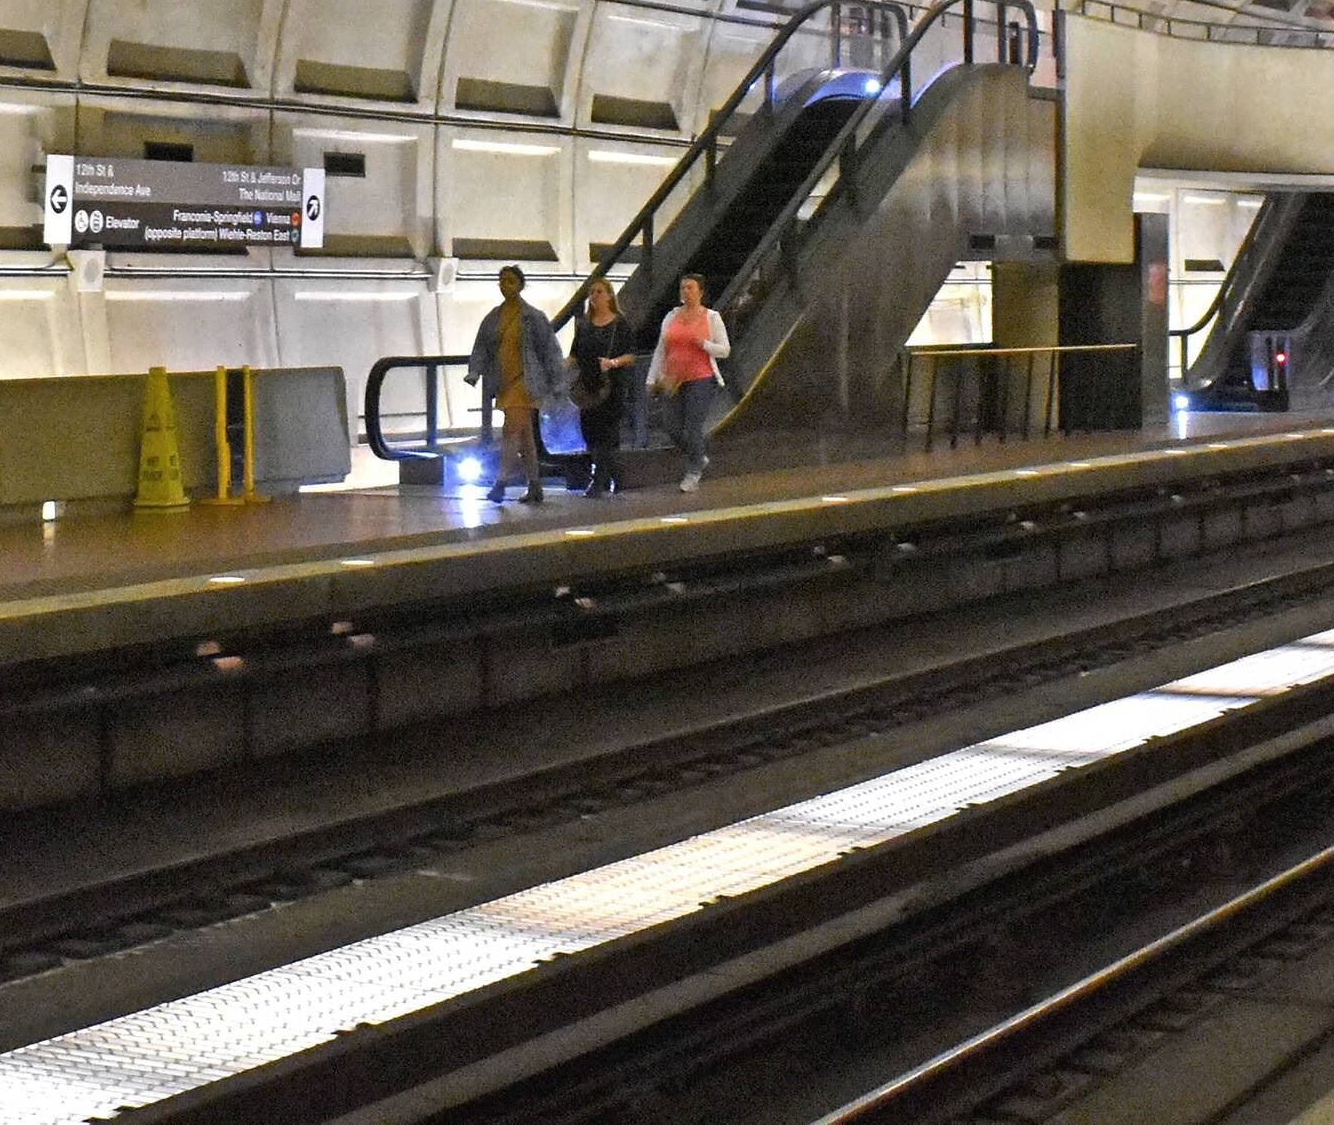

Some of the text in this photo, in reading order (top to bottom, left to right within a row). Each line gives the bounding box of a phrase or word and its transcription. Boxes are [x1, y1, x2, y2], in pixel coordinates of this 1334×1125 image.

[76, 163, 95, 176] 12th
[96, 163, 106, 177] St
[75, 181, 151, 197] Independence Ave
[238, 187, 254, 201] The
[254, 188, 285, 202] National
[105, 215, 140, 229] Elevator
[173, 209, 254, 226] Franconia-Springfield
[266, 212, 291, 225] Vienna
[144, 225, 182, 242] (opposite
[182, 226, 218, 242] platform)
[218, 227, 273, 241] Wiehle-Reston
[273, 228, 291, 242] East
